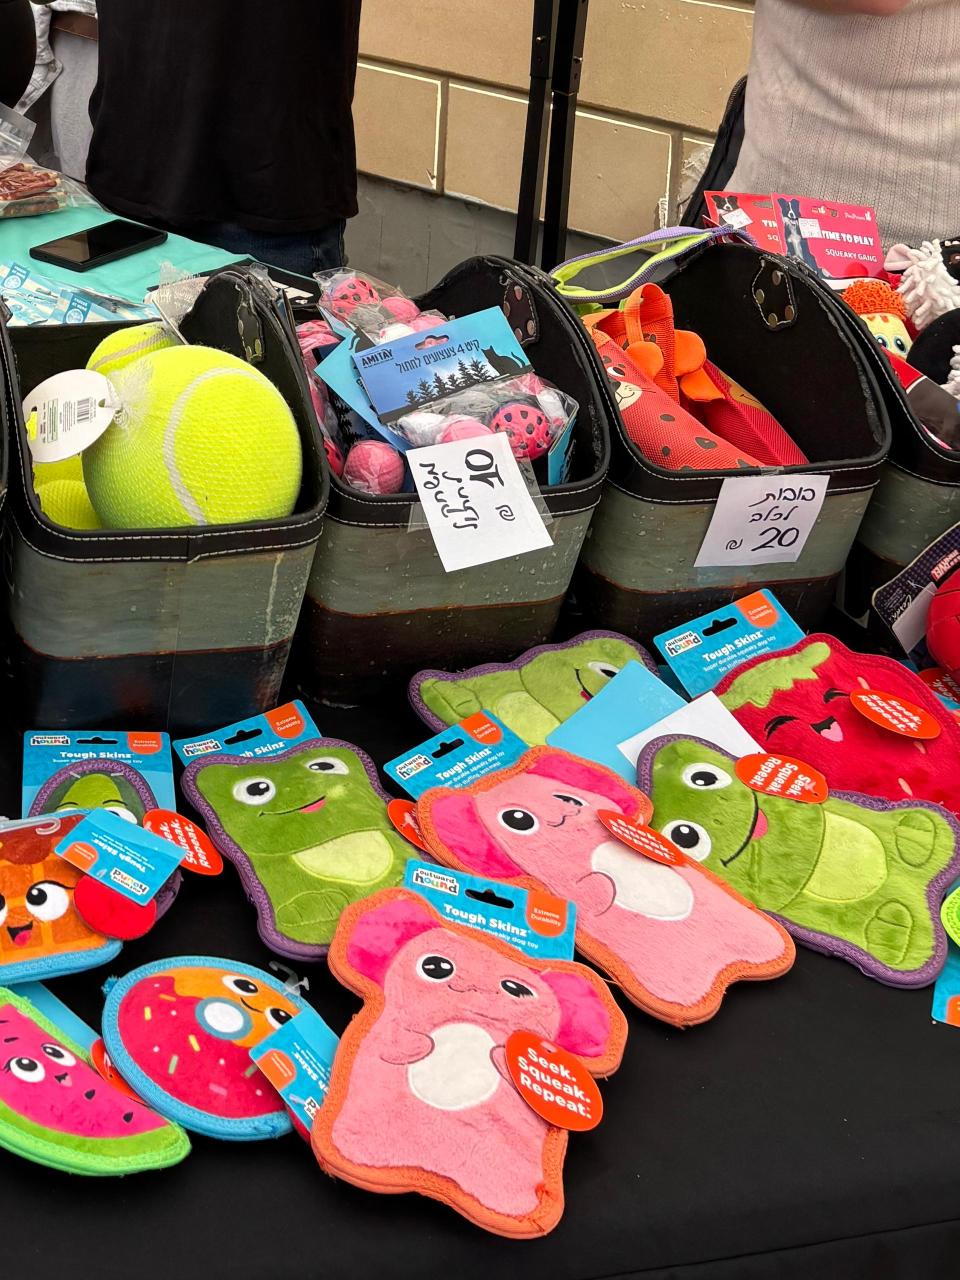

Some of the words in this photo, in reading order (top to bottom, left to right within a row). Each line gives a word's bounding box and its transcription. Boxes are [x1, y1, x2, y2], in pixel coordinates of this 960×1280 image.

[841, 232, 853, 243] TO
[854, 235, 874, 246] PLAY
[858, 253, 878, 263] GANG
[361, 349, 394, 367] AMITAY
[457, 344, 466, 355] 4
[464, 448, 505, 489] 10
[747, 487, 816, 508] בובות
[748, 505, 799, 523] לכלב
[751, 526, 800, 551] 20
[667, 635, 701, 655] hound
[702, 640, 736, 663] Tough
[733, 631, 763, 648] Skinz
[60, 751, 97, 759] Tough
[185, 742, 221, 756] hound
[254, 741, 286, 754] Skinz
[399, 757, 432, 779] hound
[435, 762, 467, 781] Tough
[464, 747, 492, 765] Skinz
[119, 852, 146, 872] Tough
[112, 869, 148, 893] hound
[415, 872, 458, 894] hound
[419, 870, 455, 883] outward
[443, 903, 487, 925] Tough
[489, 917, 529, 937] Skinz
[530, 913, 561, 927] Durability
[533, 907, 560, 919] Extreme
[511, 936, 526, 946] dog
[527, 941, 539, 950] toy
[527, 1047, 577, 1083] Seek.
[518, 1055, 591, 1103] Squeak.
[520, 1072, 592, 1119] Repeat.
